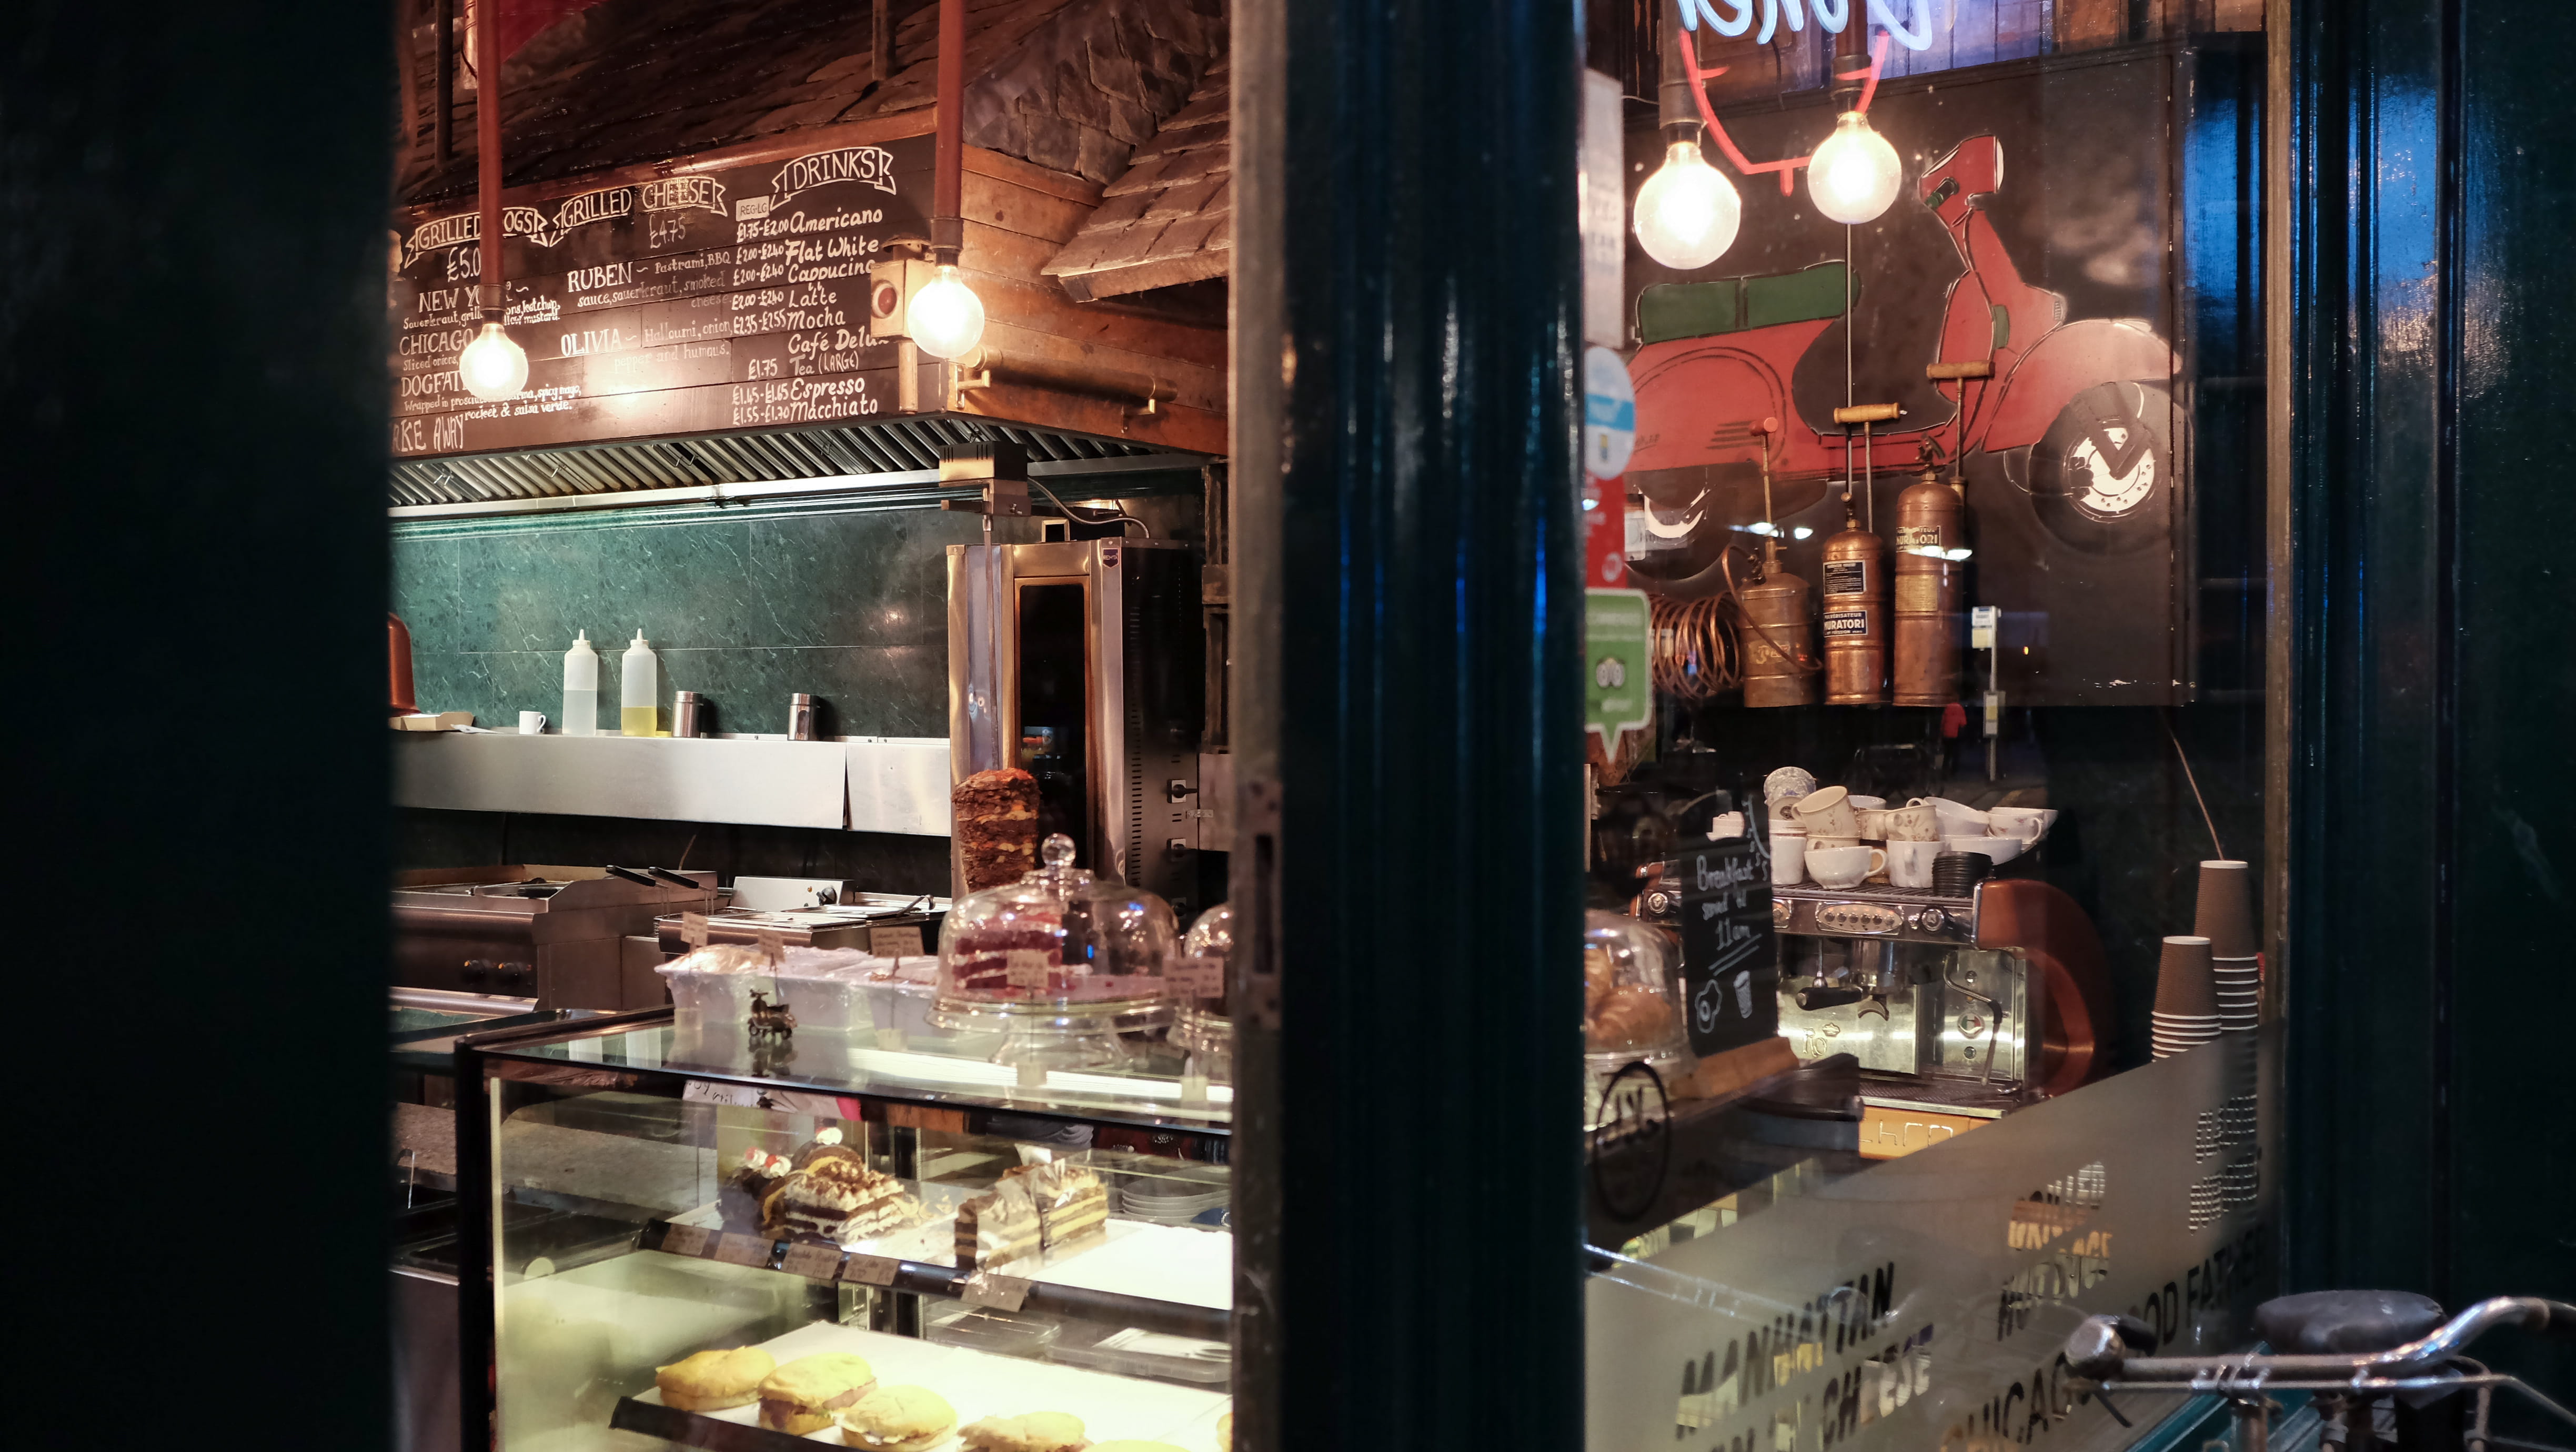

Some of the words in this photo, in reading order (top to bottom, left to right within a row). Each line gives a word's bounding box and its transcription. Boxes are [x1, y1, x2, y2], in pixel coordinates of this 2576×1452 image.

[793, 149, 876, 190] DRINKS
[565, 188, 631, 228] GRILLED
[642, 179, 711, 210] CHEESE
[419, 215, 480, 250] GRILLED
[504, 211, 535, 235] OGS
[649, 214, 686, 249] £4.75
[790, 207, 883, 234] Americano
[447, 246, 481, 283] £5.0
[785, 238, 823, 266] Flat
[827, 235, 879, 258] White
[567, 262, 634, 293] RUBEN
[655, 254, 708, 274] Pastrami,
[708, 251, 731, 266] BBQ
[684, 269, 726, 291] smoked
[419, 288, 459, 313] NEW
[789, 287, 838, 308] Latte
[787, 305, 846, 331] Mocha
[399, 328, 475, 357] CHICAGO
[561, 328, 622, 357] OLIVIA
[788, 331, 830, 361] Café
[834, 325, 889, 351] Delu
[613, 351, 653, 374] pepper
[656, 345, 679, 363] and
[748, 358, 778, 381] £1.75
[789, 354, 816, 376] Tea
[818, 350, 859, 375] (LARGE)
[404, 395, 441, 414] Wrapped
[441, 396, 449, 407] in
[790, 377, 866, 408] Espresso
[790, 394, 878, 421] Macchiato
[465, 404, 498, 420] rocket
[500, 402, 511, 417] &
[514, 400, 539, 416] salsa
[393, 419, 426, 452] AKE
[434, 414, 465, 452] AWAY
[1675, 1261, 1895, 1441] MANHATTAN
